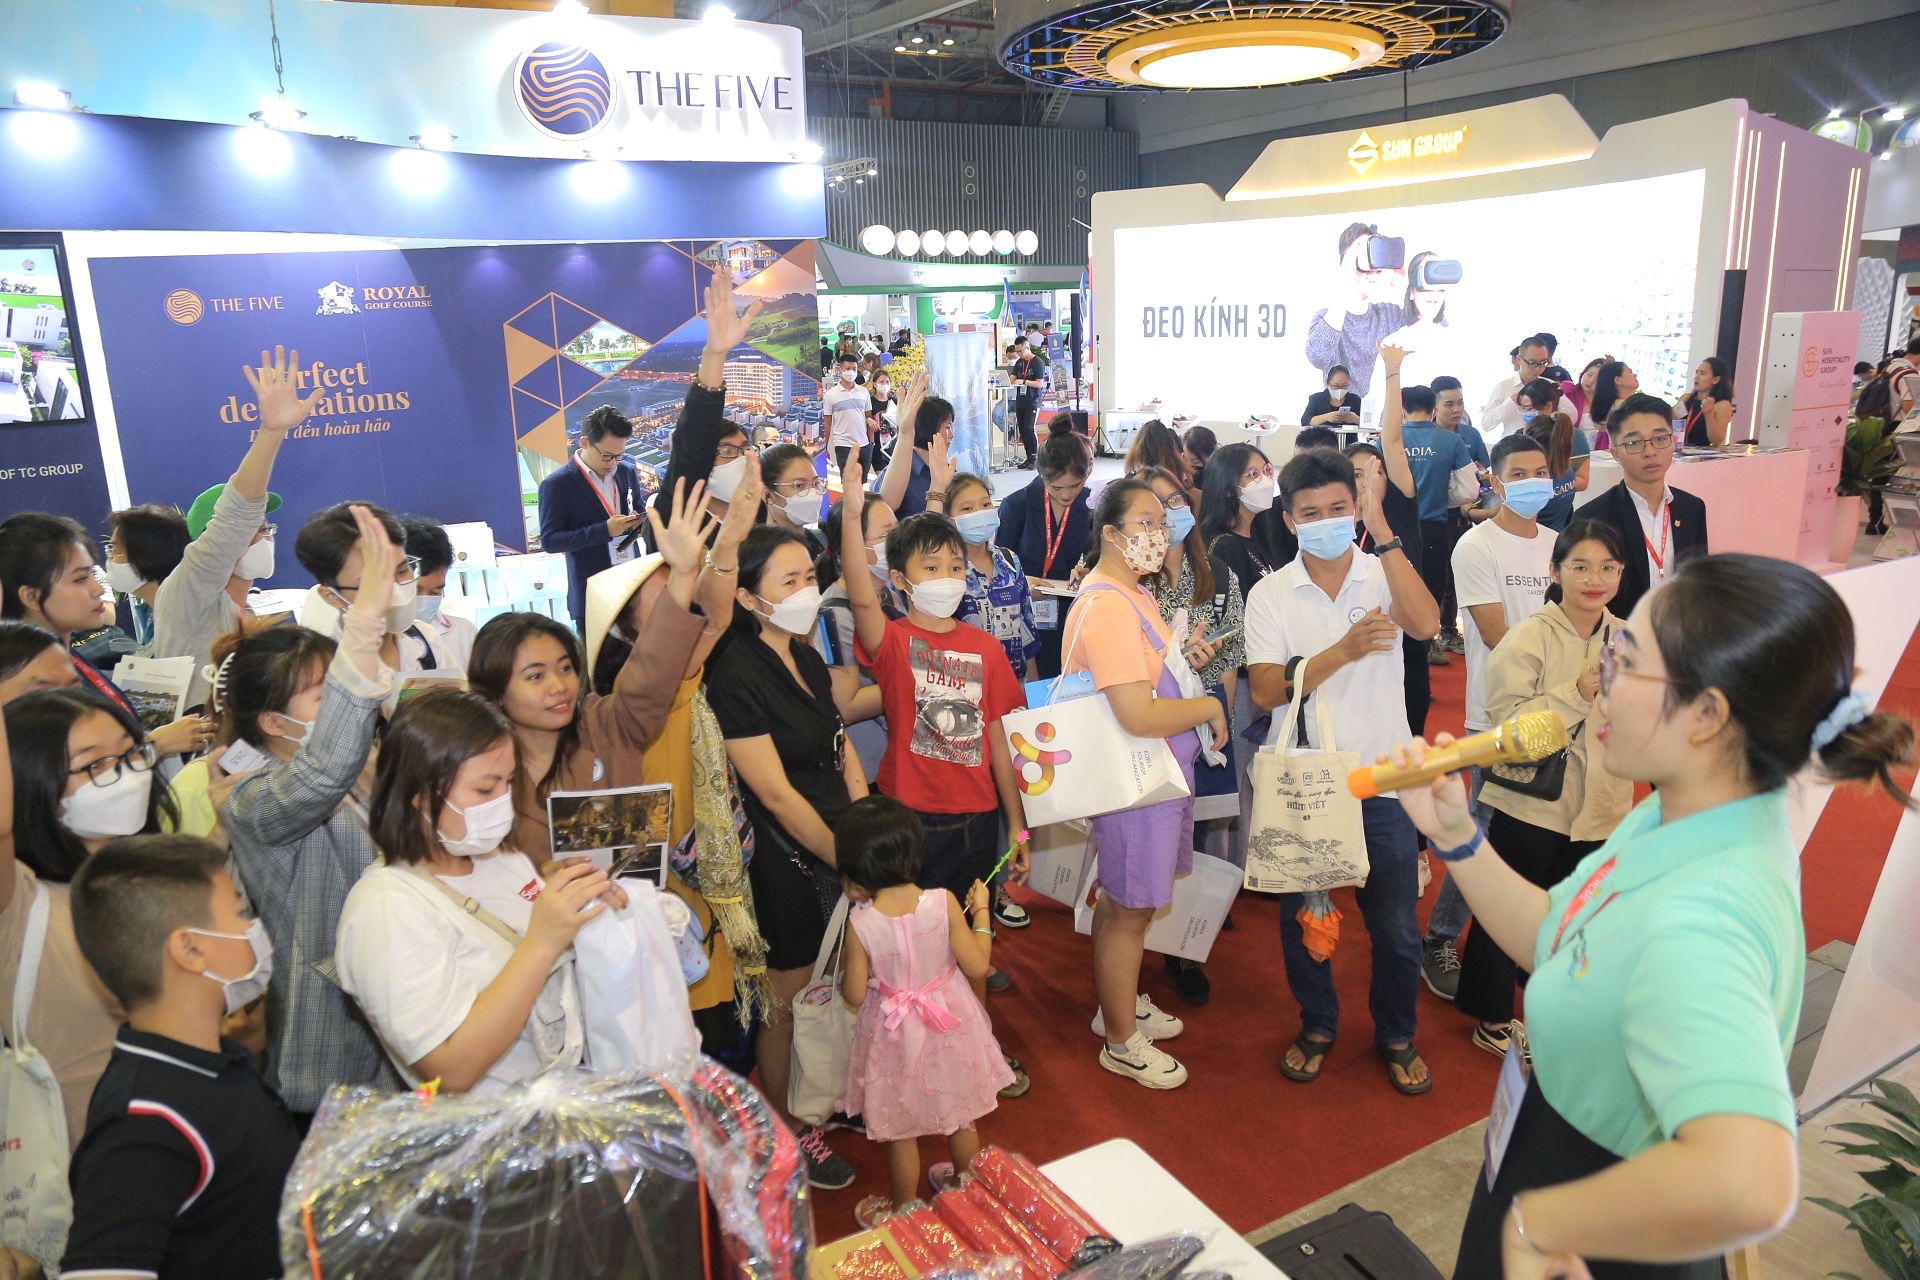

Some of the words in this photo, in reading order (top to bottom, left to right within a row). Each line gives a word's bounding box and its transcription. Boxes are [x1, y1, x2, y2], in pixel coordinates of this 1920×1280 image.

[627, 70, 705, 107] THE
[715, 74, 793, 111] FIVE
[1381, 138, 1412, 161] SUN
[1414, 129, 1464, 157] GROUP
[363, 285, 431, 301] ROYAL
[210, 298, 245, 313] THE
[248, 296, 284, 311] FIVE
[364, 302, 391, 310] GOLF
[393, 300, 433, 308] COURSE
[1143, 305, 1184, 338] ĐEO
[1194, 296, 1248, 338] KÍNH
[1257, 303, 1286, 338] 3D
[1821, 355, 1851, 365] HOSPITALITY
[1822, 348, 1833, 356] SUN
[255, 361, 368, 390] Prfect
[1819, 366, 1837, 375] GROUP
[219, 388, 410, 424] deations
[293, 419, 320, 439] đến
[324, 421, 360, 436] hoàn
[364, 418, 391, 433] hảo
[0, 469, 15, 480] OF
[18, 467, 36, 478] TC
[39, 463, 83, 477] GROUP
[1137, 751, 1146, 775] TOURISM
[1144, 750, 1152, 768] KOREA
[1131, 751, 1143, 794] ORGANIZATION
